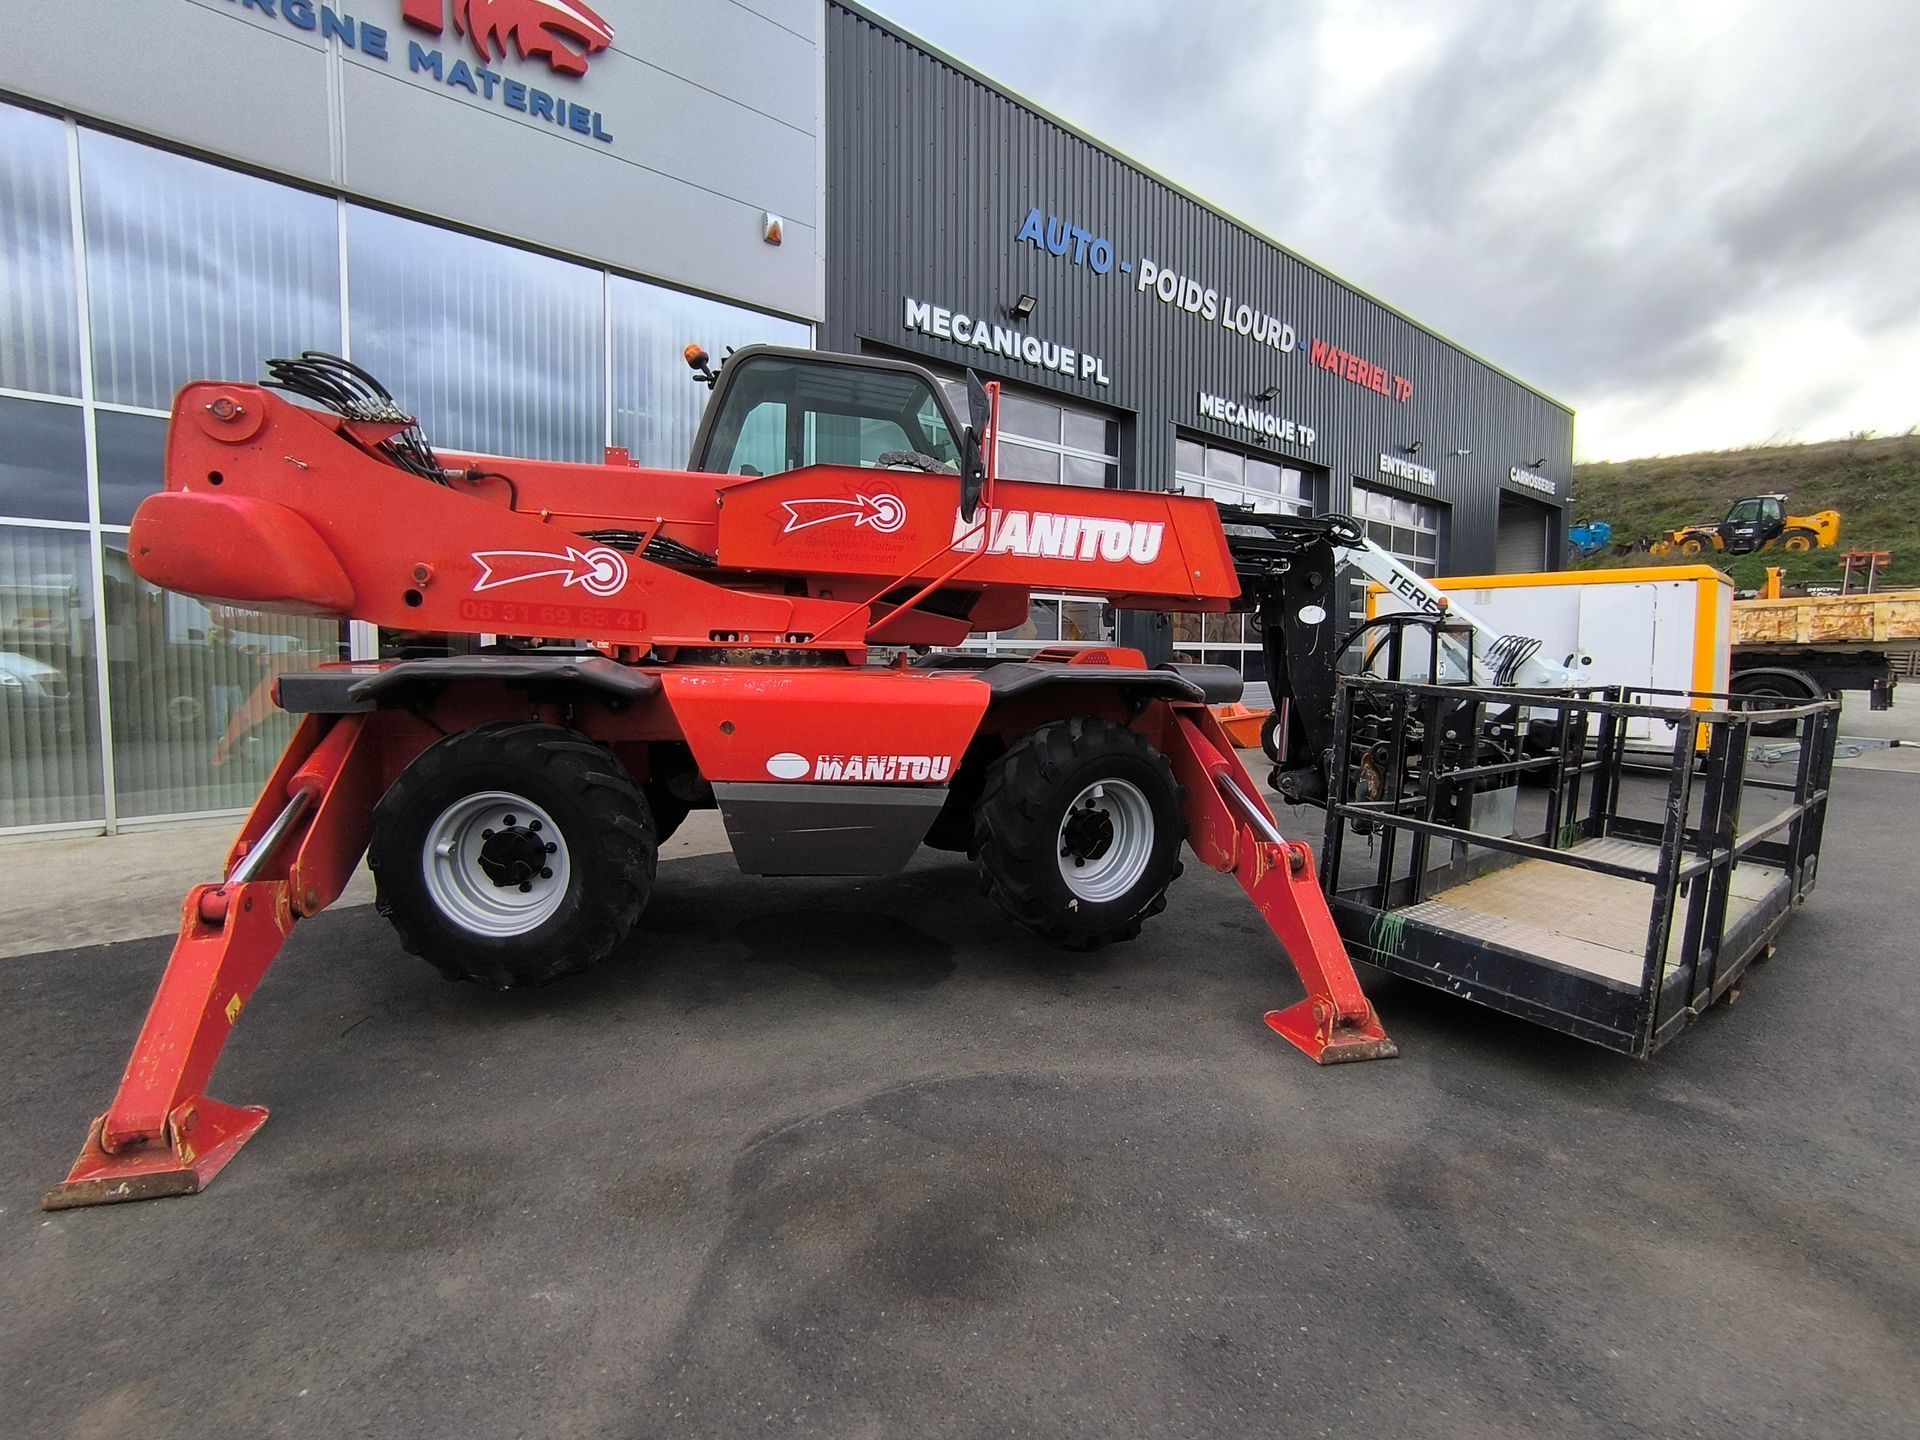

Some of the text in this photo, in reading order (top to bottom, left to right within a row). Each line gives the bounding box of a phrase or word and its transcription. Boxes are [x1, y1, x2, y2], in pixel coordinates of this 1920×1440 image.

[409, 40, 613, 143] MATERIEL
[1016, 207, 1114, 274] AUTO
[1138, 258, 1218, 321] POIDS
[1222, 297, 1296, 353] LOURD
[1310, 337, 1391, 396] MATERIEL
[1393, 375, 1413, 403] TP
[905, 298, 1109, 385] MECANIQUE PL
[1200, 391, 1315, 446] MECANIQUE TP
[1379, 453, 1436, 486] ENTRETIEN
[1509, 466, 1555, 495] CARROSSERIE
[951, 506, 1166, 565] MANITOU
[462, 601, 493, 619] 06
[814, 755, 951, 781] MANITOU
